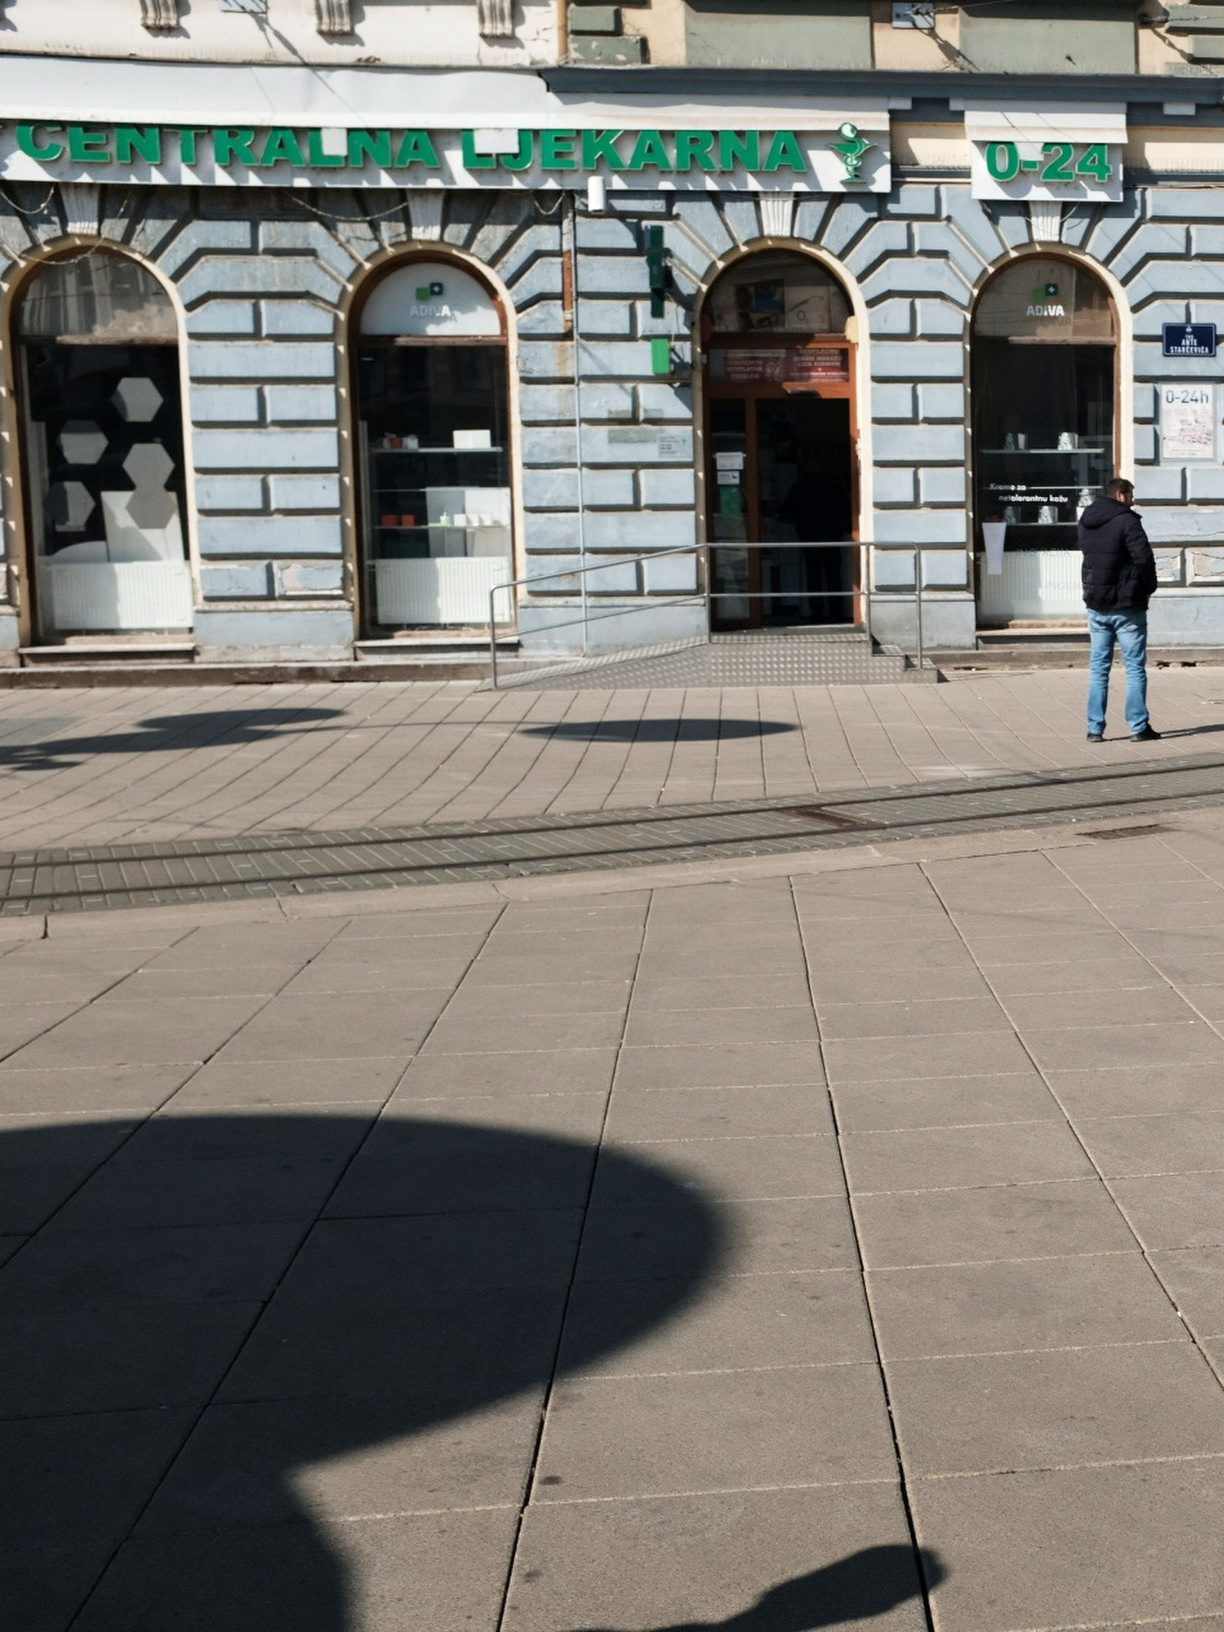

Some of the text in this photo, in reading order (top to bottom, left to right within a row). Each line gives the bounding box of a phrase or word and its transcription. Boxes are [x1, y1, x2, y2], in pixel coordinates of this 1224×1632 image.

[16, 121, 807, 173] CENTRALNA LJEKARNA
[985, 141, 1113, 182] 0-24
[1026, 304, 1065, 317] ADIVA
[1166, 389, 1210, 404] 0-24h
